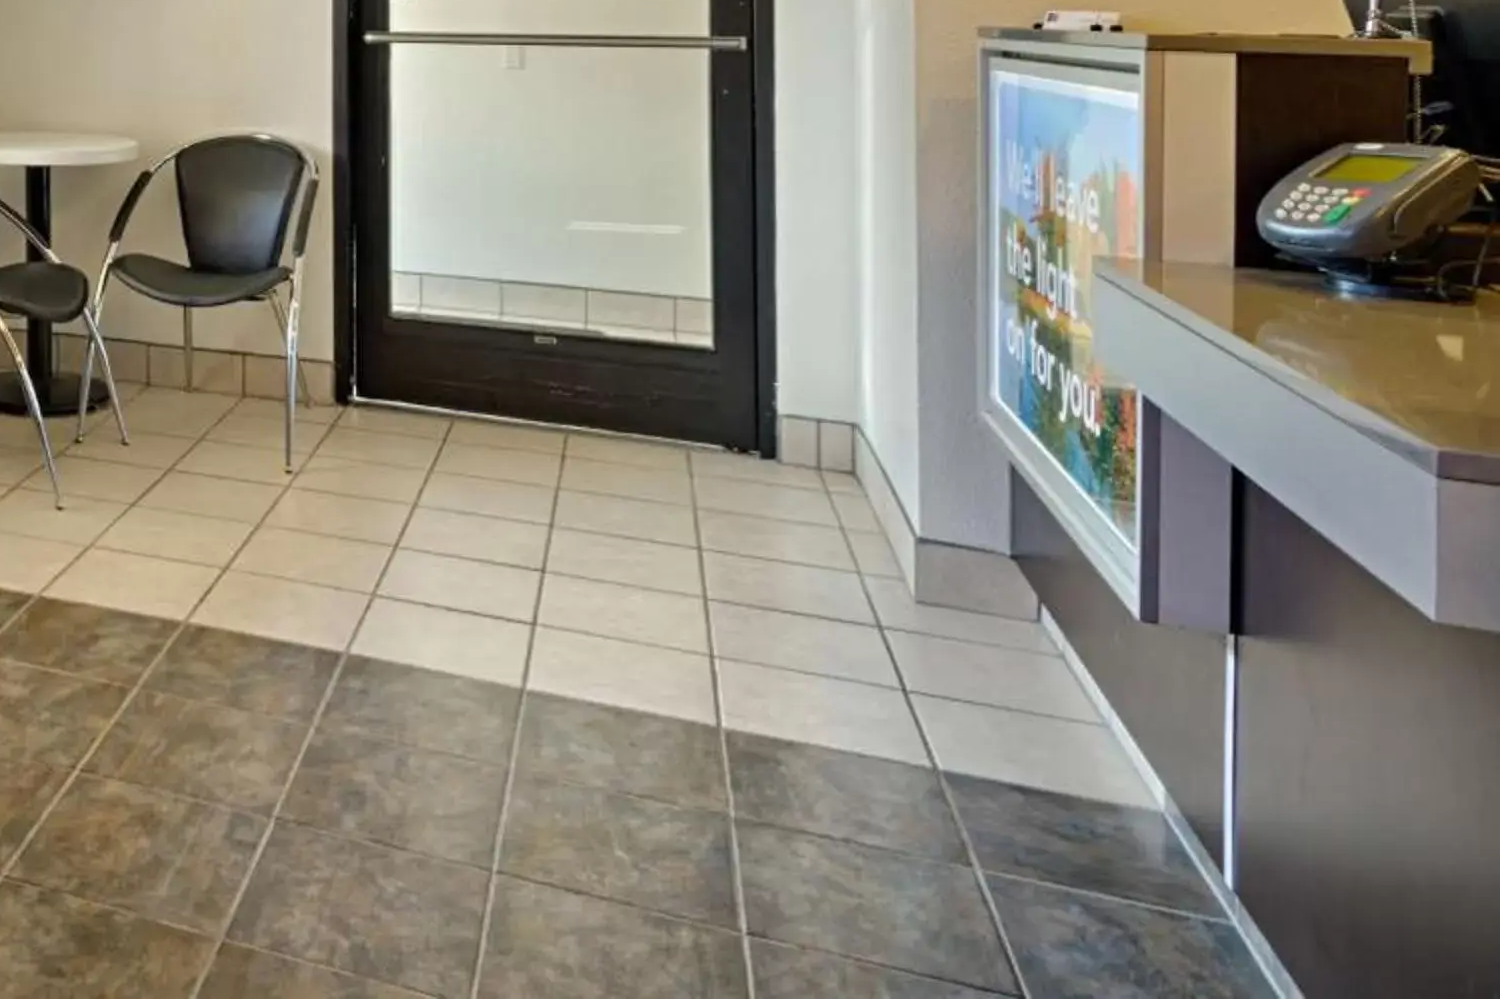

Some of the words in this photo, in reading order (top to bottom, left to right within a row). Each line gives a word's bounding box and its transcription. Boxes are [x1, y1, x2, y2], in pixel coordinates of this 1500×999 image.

[1049, 154, 1100, 234] leave
[1006, 220, 1033, 286] the
[1036, 234, 1079, 320] light
[1006, 318, 1026, 367] on
[1030, 319, 1056, 392] for
[1058, 362, 1102, 438] you.
